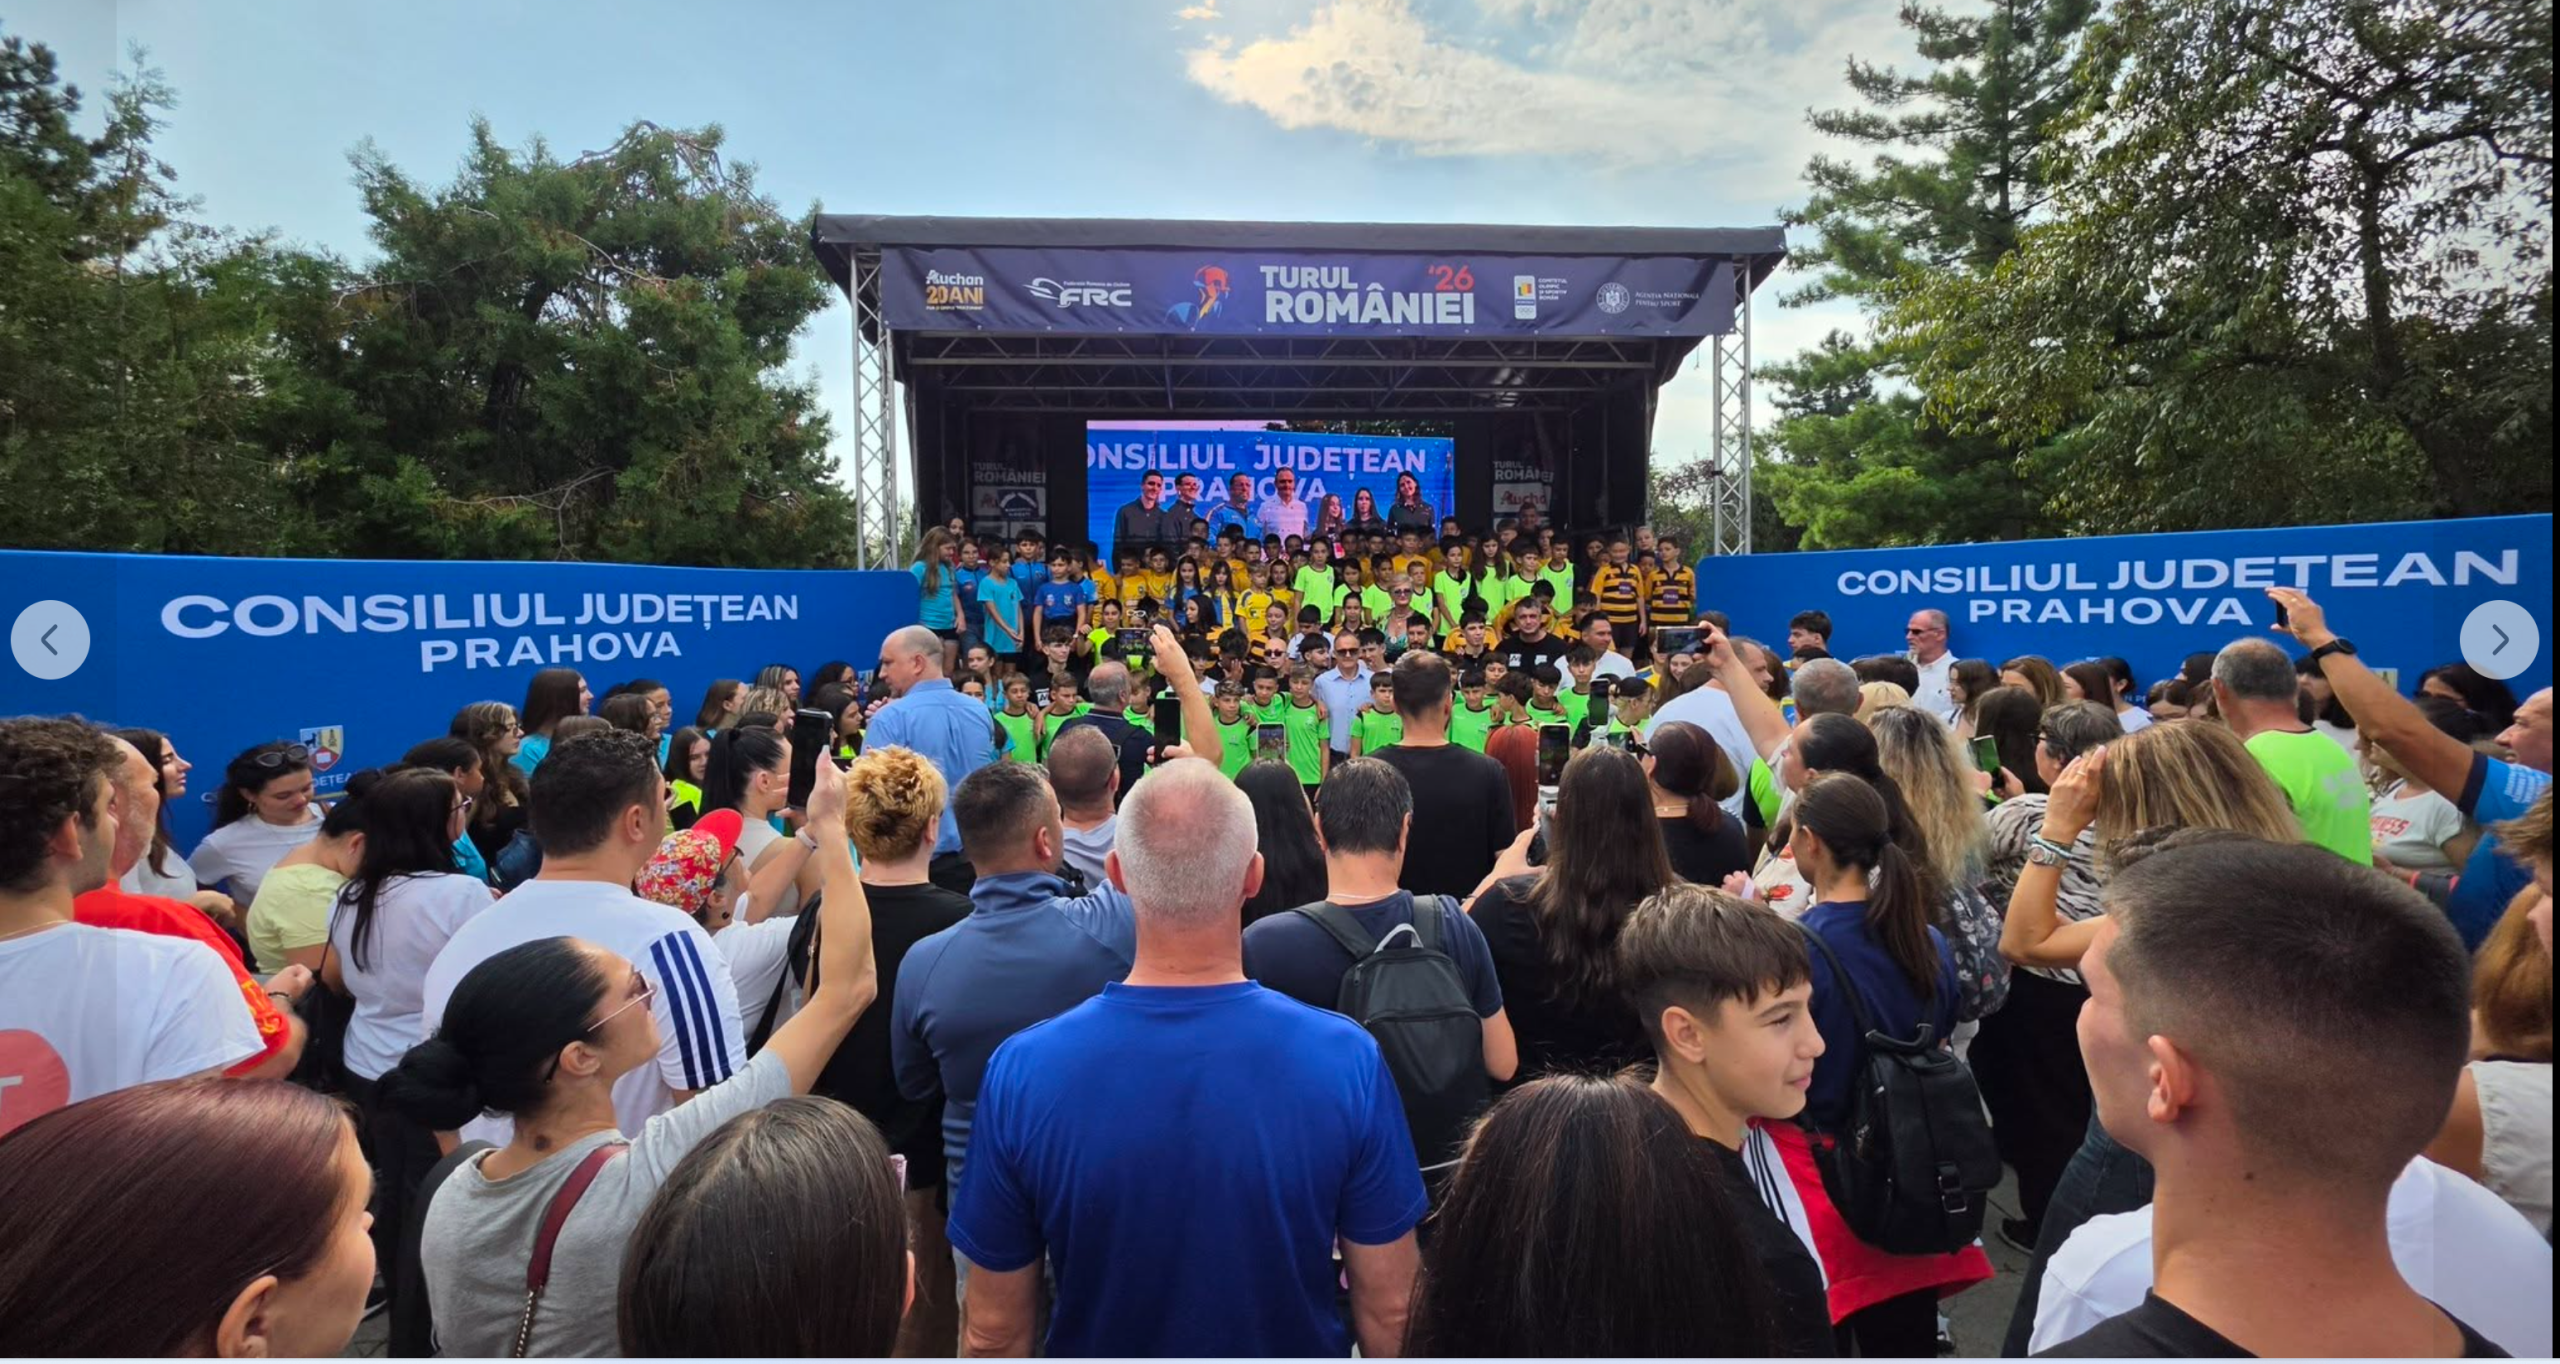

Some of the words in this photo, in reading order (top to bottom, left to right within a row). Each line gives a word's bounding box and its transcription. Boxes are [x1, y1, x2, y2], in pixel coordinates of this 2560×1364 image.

[926, 269, 983, 286] Auchan
[1260, 266, 1358, 289] TURUL
[1059, 288, 1132, 307] FRC
[1266, 283, 1474, 324] ROMÂNIEI
[1087, 443, 1236, 470] NSILIUL
[1253, 444, 1426, 480] JUDEȚEAN
[1493, 461, 1523, 469] TURUL
[974, 468, 1046, 483] ROMÂNIEI
[1500, 490, 1547, 505] Aucha
[1837, 562, 2097, 596] CONSILIUL
[160, 593, 565, 638] CONSILIUL
[574, 594, 798, 631] JUDEȚEAN
[1969, 597, 2253, 625] PRAHOVA
[420, 631, 682, 673] PRAHOVA
